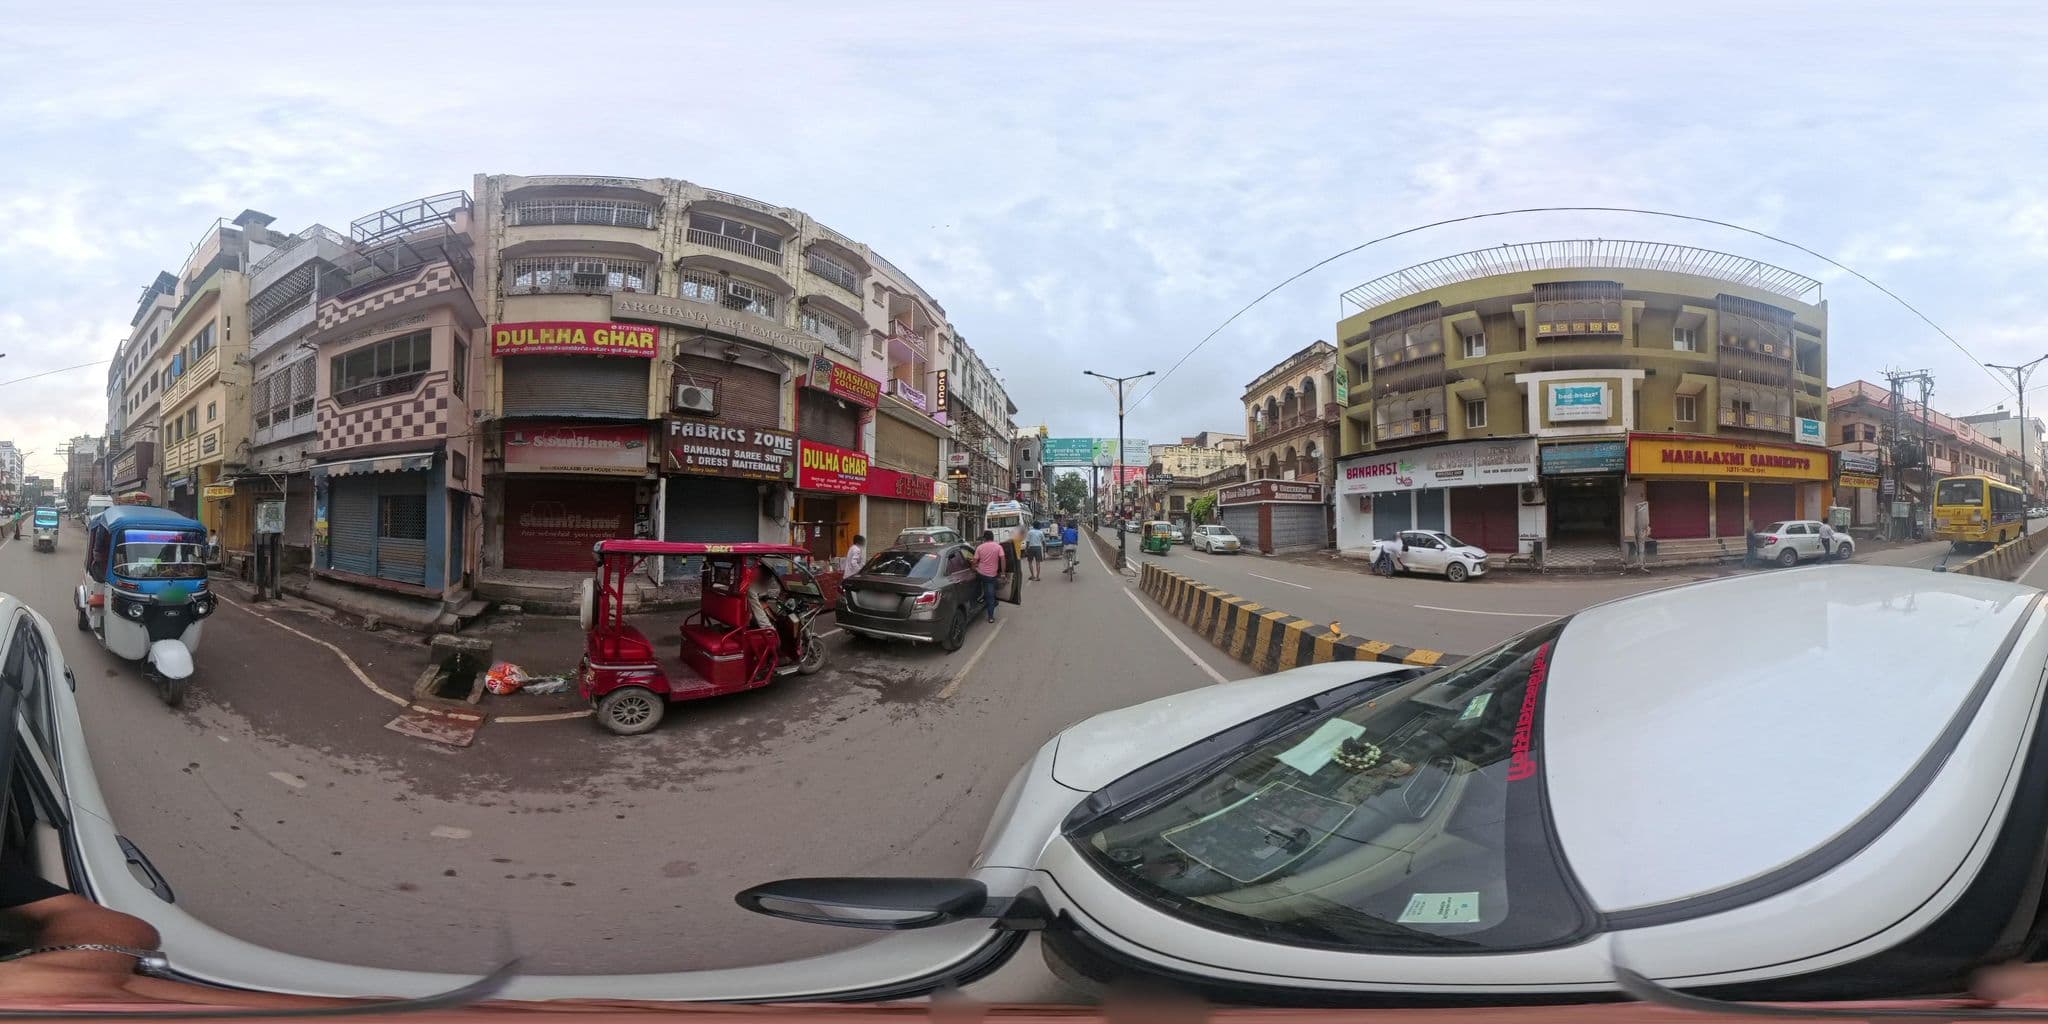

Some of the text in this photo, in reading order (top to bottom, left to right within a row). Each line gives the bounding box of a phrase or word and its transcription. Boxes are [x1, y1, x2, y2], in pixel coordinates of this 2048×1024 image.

[593, 328, 655, 349] GHAR
[618, 300, 822, 355] ARCHANA ART EMPORIUM
[833, 367, 878, 393] SHASHANK
[834, 378, 876, 399] COLLECTION
[671, 421, 793, 450] FABRICS ZONE
[683, 444, 730, 457] BANARASI
[734, 449, 761, 461] SAREE
[764, 454, 784, 464] SUIT
[686, 455, 694, 464] &
[698, 456, 728, 467] DRESS
[802, 447, 868, 477] DULHA GHAR
[1661, 448, 1811, 471] MAHALAXMI GARMENTS
[1346, 461, 1398, 481] BANARASI
